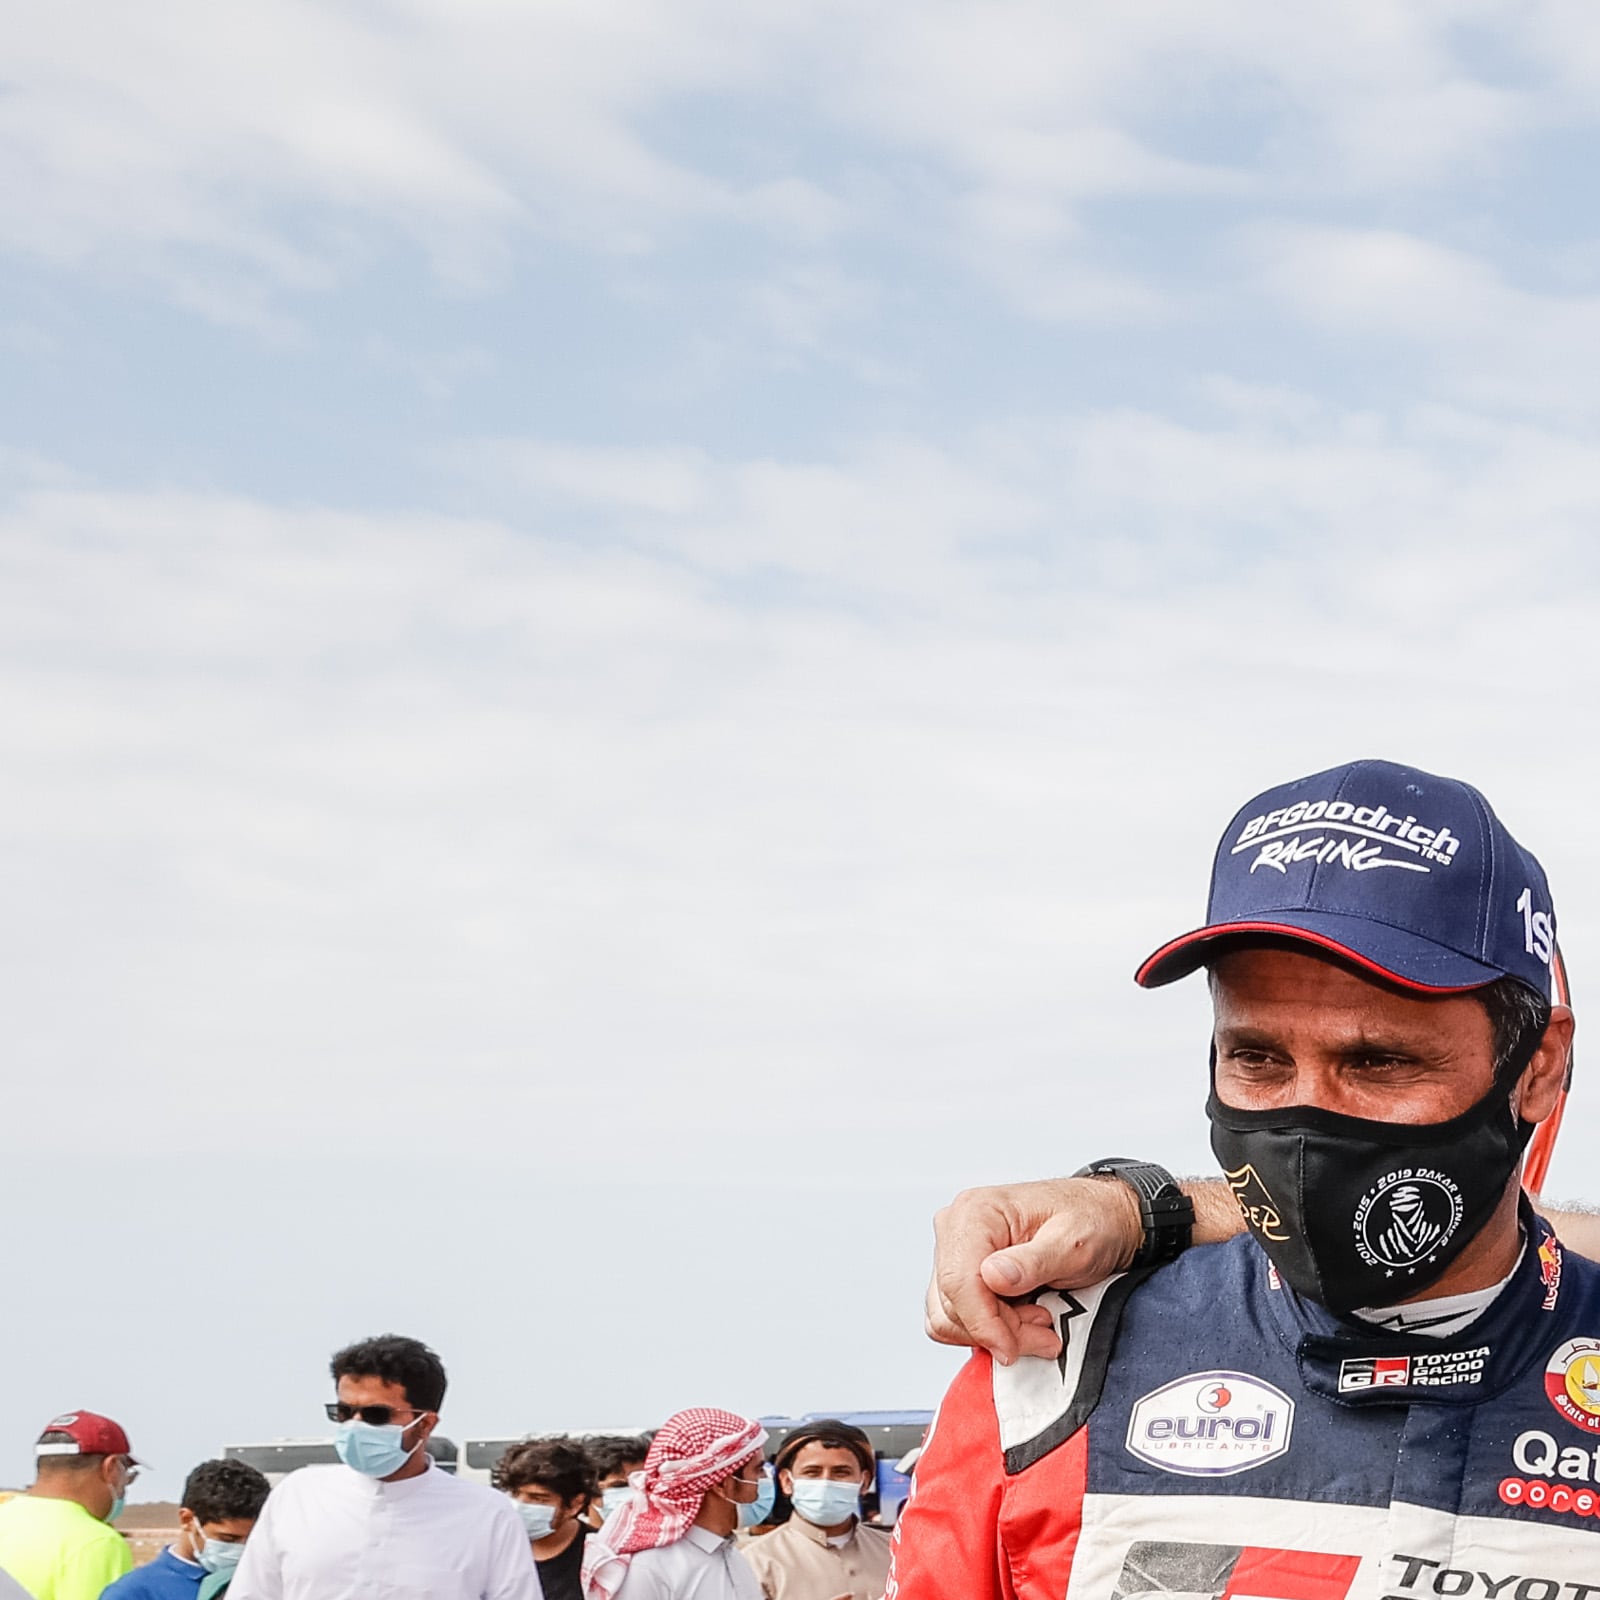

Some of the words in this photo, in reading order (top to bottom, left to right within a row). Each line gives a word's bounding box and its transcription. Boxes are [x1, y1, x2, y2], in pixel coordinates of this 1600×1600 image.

[1239, 800, 1461, 856] BFGoodrich
[1250, 836, 1431, 874] RACING
[1376, 1168, 1412, 1188] 2019
[1415, 1168, 1459, 1193] DAKAR
[1441, 1194, 1464, 1247] WINNER
[1412, 1346, 1490, 1366] TOYOTA
[1342, 1368, 1408, 1387] GR
[1412, 1359, 1484, 1377] GAZOO
[1412, 1371, 1482, 1386] Racing
[1146, 1411, 1276, 1441] eurol
[1142, 1442, 1271, 1452] LUBRICANTS
